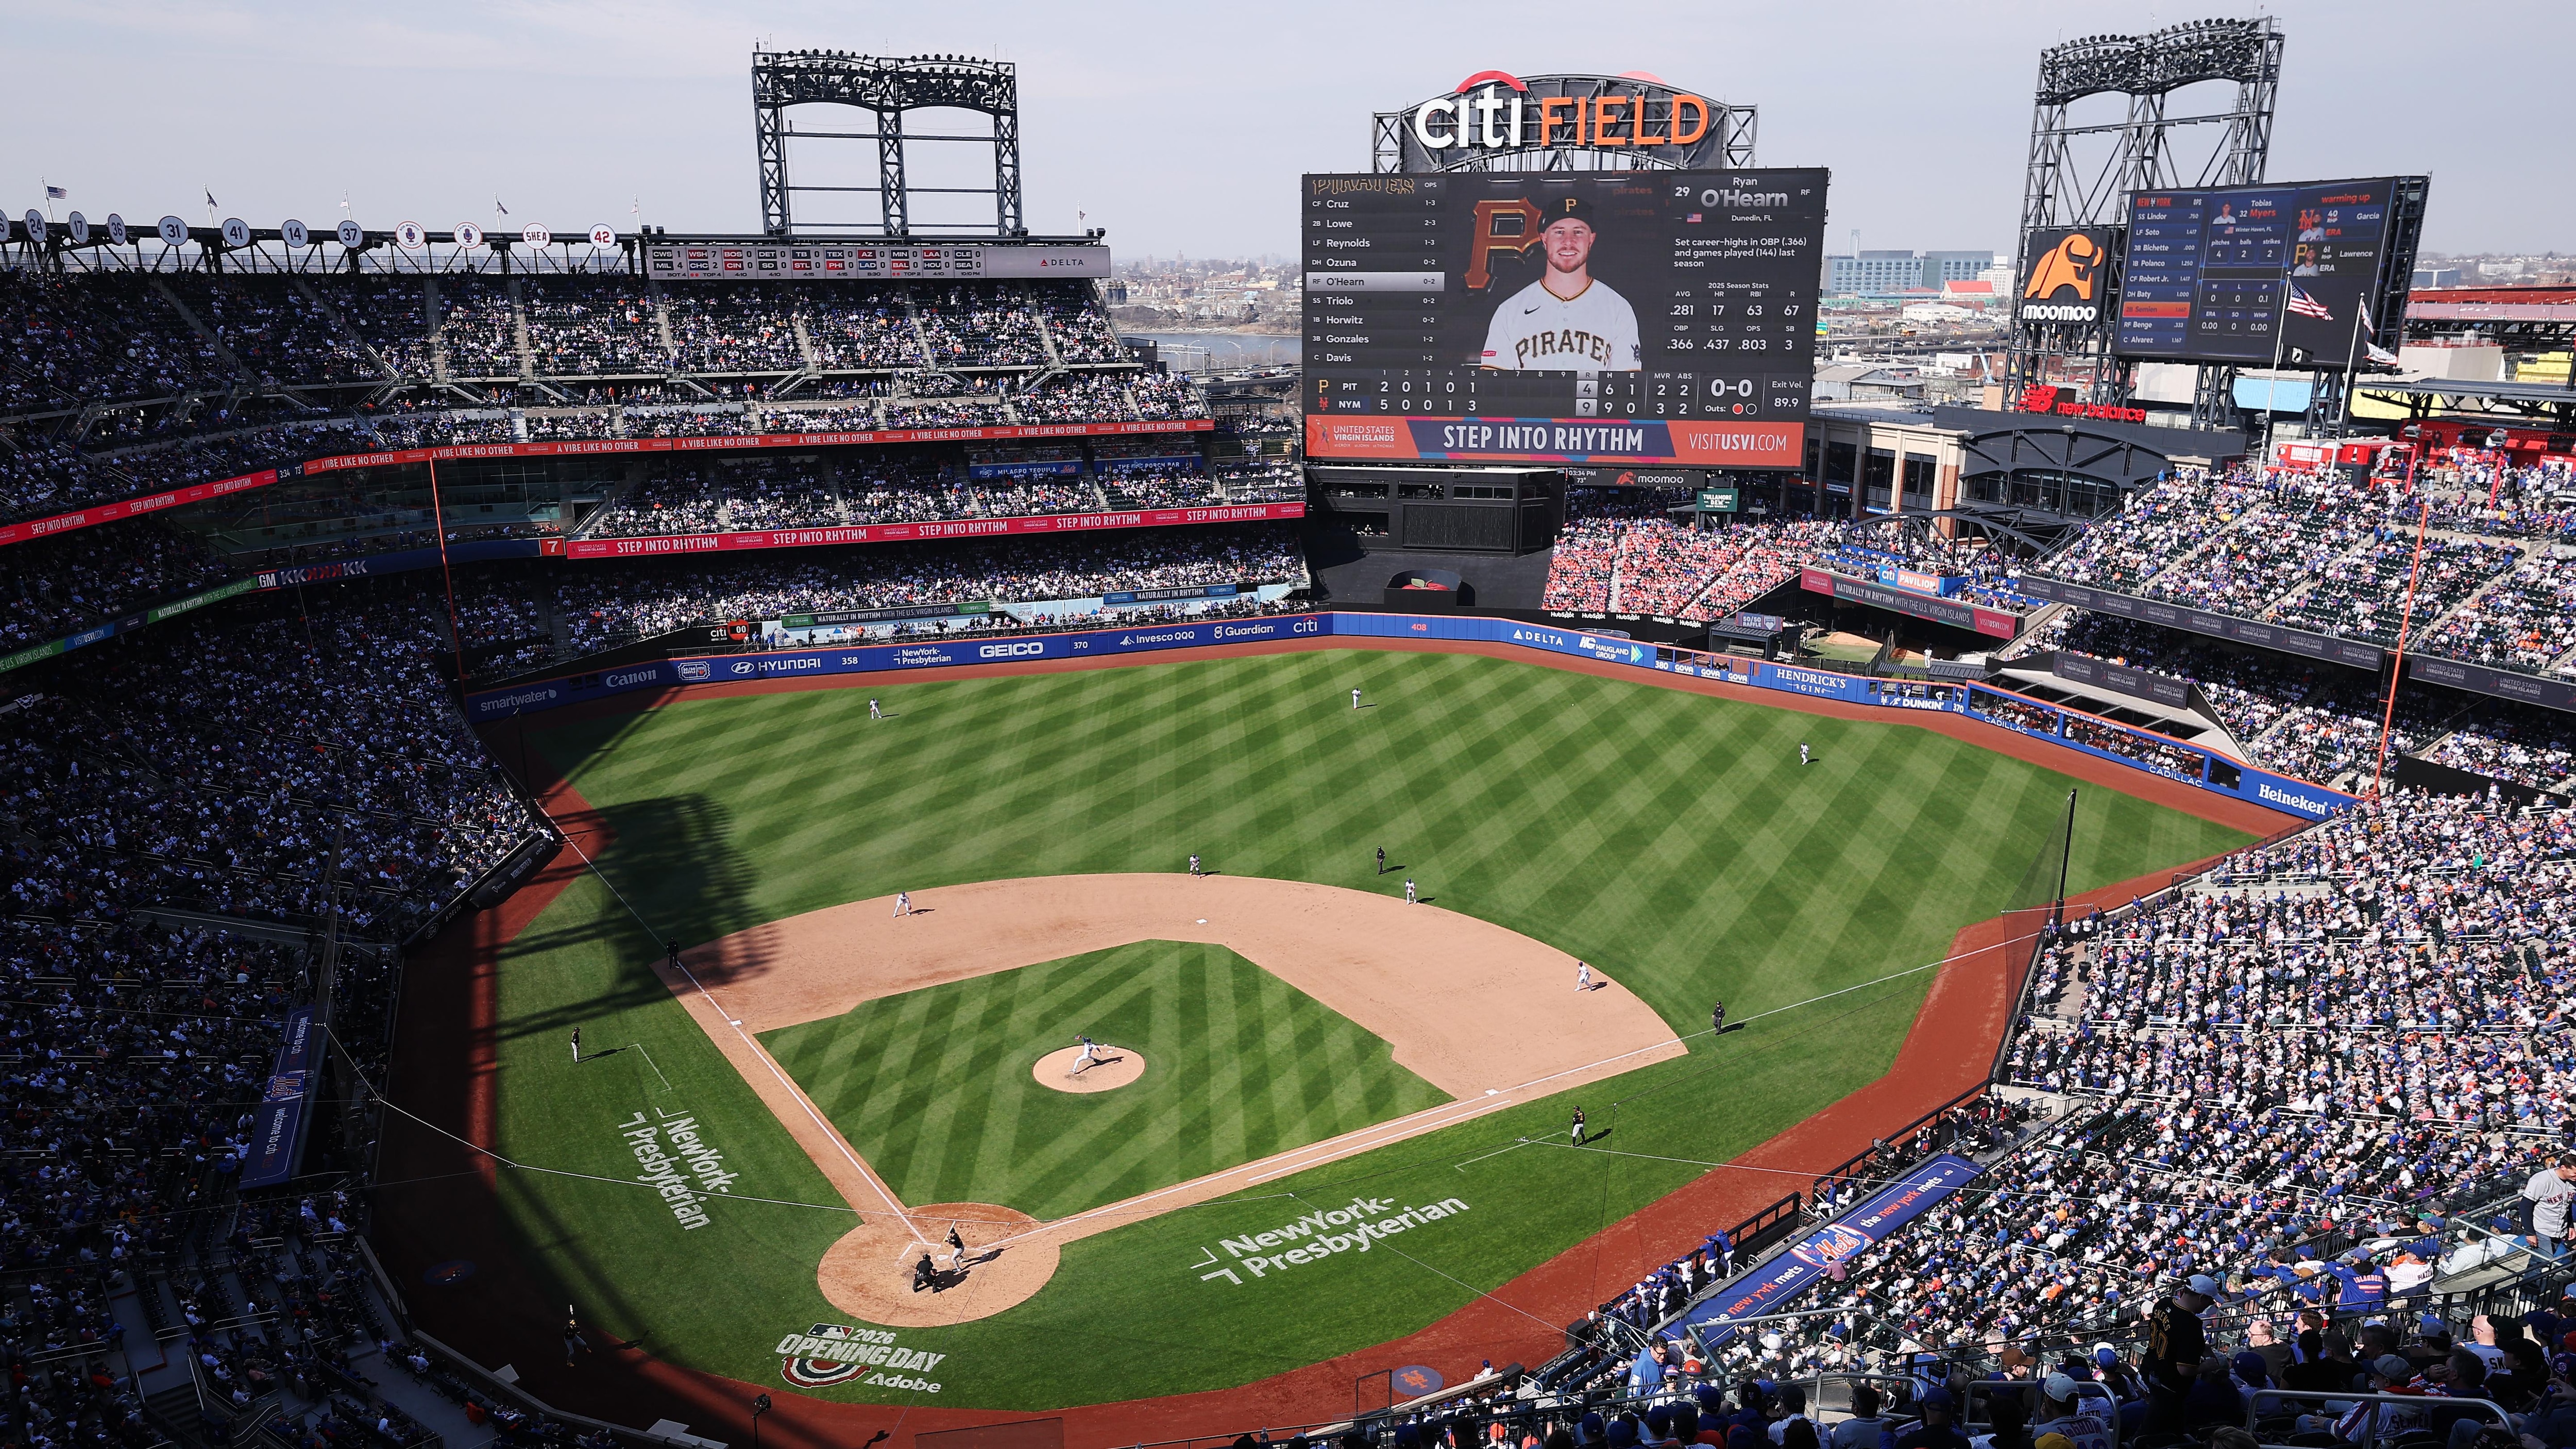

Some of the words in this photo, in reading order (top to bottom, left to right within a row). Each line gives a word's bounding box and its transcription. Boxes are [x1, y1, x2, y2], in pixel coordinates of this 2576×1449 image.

[1415, 85, 1522, 148] citi
[1541, 94, 1709, 146] FIELD
[1733, 177, 1757, 188] Ryan
[1675, 187, 1689, 196] 29
[1327, 200, 1349, 208] Cruz
[1701, 190, 1788, 207] O'Hearn
[2321, 194, 2357, 204] warming
[2359, 194, 2370, 202] up
[2250, 209, 2276, 219] Myers
[29, 218, 43, 234] 24
[74, 221, 82, 235] 17
[111, 222, 123, 236] 36
[1327, 220, 1352, 228] Lowe
[166, 224, 180, 238] 31
[230, 226, 243, 239] 41
[289, 227, 301, 240] 14
[343, 228, 357, 241] 37
[527, 232, 546, 241] SHEA
[595, 231, 609, 243] 42
[1327, 239, 1370, 249] Reynolds
[1692, 238, 1748, 248] career-highs
[1782, 237, 1806, 246] (.366)
[1724, 248, 1754, 258] played
[1756, 248, 1776, 257] (144)
[1327, 296, 1353, 305] Triolo
[1670, 305, 1693, 315] .281
[1713, 305, 1724, 315] 17
[1747, 305, 1762, 315] 63
[1784, 306, 1799, 315] 67
[2022, 305, 2097, 322] moomoo
[1327, 334, 1369, 343] Gonzales
[1516, 329, 1612, 369] PIRATES
[1327, 353, 1351, 362] Davis
[1711, 379, 1752, 397] 0-0
[1787, 380, 1803, 389] Vel.
[1774, 398, 1798, 407] 89.9
[2057, 401, 2085, 415] new
[2087, 402, 2146, 422] balance
[1334, 426, 1364, 434] UNITED
[1366, 426, 1394, 434] STATES
[1444, 426, 1492, 448] STEP
[1499, 427, 1547, 449] INTO
[1555, 428, 1642, 451] RHYTHM
[1689, 433, 1786, 450] VISITUSVI.COM
[565, 444, 581, 452] VIBE
[583, 443, 600, 451] LIKE
[602, 442, 613, 451] NO
[615, 442, 639, 450] OTHER
[1637, 474, 1684, 484] moomoo
[130, 500, 142, 512] STEP
[143, 497, 155, 510] INTO
[155, 494, 175, 507] RHYTHM
[617, 541, 642, 553] STEP
[645, 540, 670, 551] INTO
[673, 537, 718, 550] RHYTHM
[1836, 582, 1865, 598] NATURALLY
[1871, 592, 1894, 604] RHYTHM
[1550, 611, 1574, 619] HubSpot
[1225, 625, 1275, 636] Guardian
[1294, 617, 1317, 632] citi
[1412, 622, 1427, 631] 408
[1137, 634, 1173, 643] Invesco
[1174, 630, 1195, 642] QQQ
[1524, 630, 1564, 646] DELTA
[902, 647, 941, 657] NewYork-
[979, 641, 1043, 659] GEICO
[1596, 644, 1629, 656] HAUGLAND
[1596, 650, 1617, 660] GROUP
[758, 659, 820, 671] HYUNDAI
[902, 654, 952, 665] Presbyterian
[1655, 660, 1669, 670] 380
[604, 669, 656, 687] Canon
[1776, 668, 1847, 689] HENDRICK'S
[480, 689, 548, 712] smartwater
[1902, 698, 1944, 711] DUNKIN'
[1953, 703, 1964, 713] 370
[1984, 715, 2028, 736] CADILLAC
[2148, 766, 2204, 788] CADILLAC
[2259, 783, 2327, 816] Heineken
[662, 1117, 739, 1193] NewYork-
[622, 1126, 711, 1232] Presbyterian
[1859, 1215, 1882, 1228] the
[1878, 1203, 1901, 1218] new
[1897, 1190, 1922, 1206] york
[1917, 1175, 1943, 1193] mets
[1219, 1197, 1395, 1258] NewYork-
[1241, 1197, 1470, 1278] Presbyterian
[851, 1328, 896, 1344] 2026
[775, 1334, 892, 1365] OPENING
[885, 1347, 946, 1372] DAY
[863, 1373, 942, 1393] Adobe
